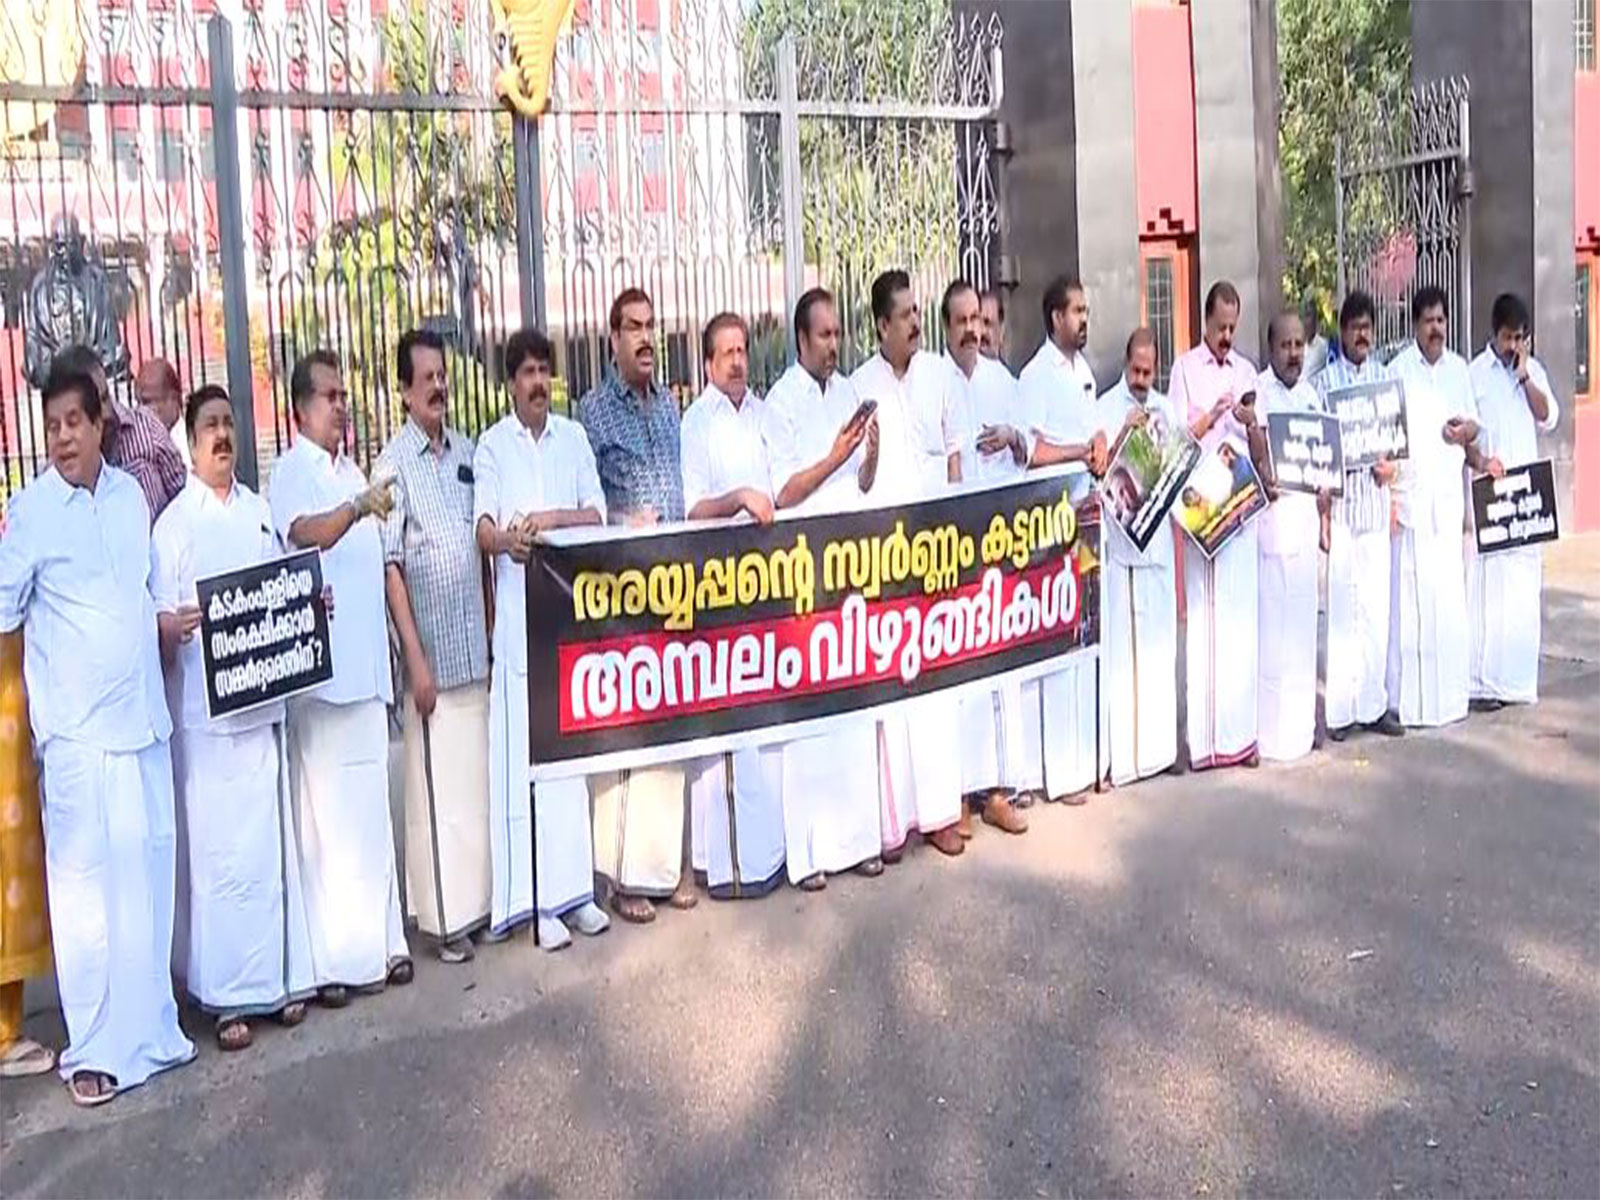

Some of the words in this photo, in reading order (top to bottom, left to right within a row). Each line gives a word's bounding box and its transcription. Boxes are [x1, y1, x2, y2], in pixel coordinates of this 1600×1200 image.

[572, 533, 815, 631] അയ്യപ്പന്റെ
[822, 521, 975, 599] സ്വർണ്ണം
[981, 489, 1076, 570] കട്ടവർ
[570, 631, 803, 721] അമ്പലം
[808, 554, 1077, 684] വിഴുങ്ങികൾ
